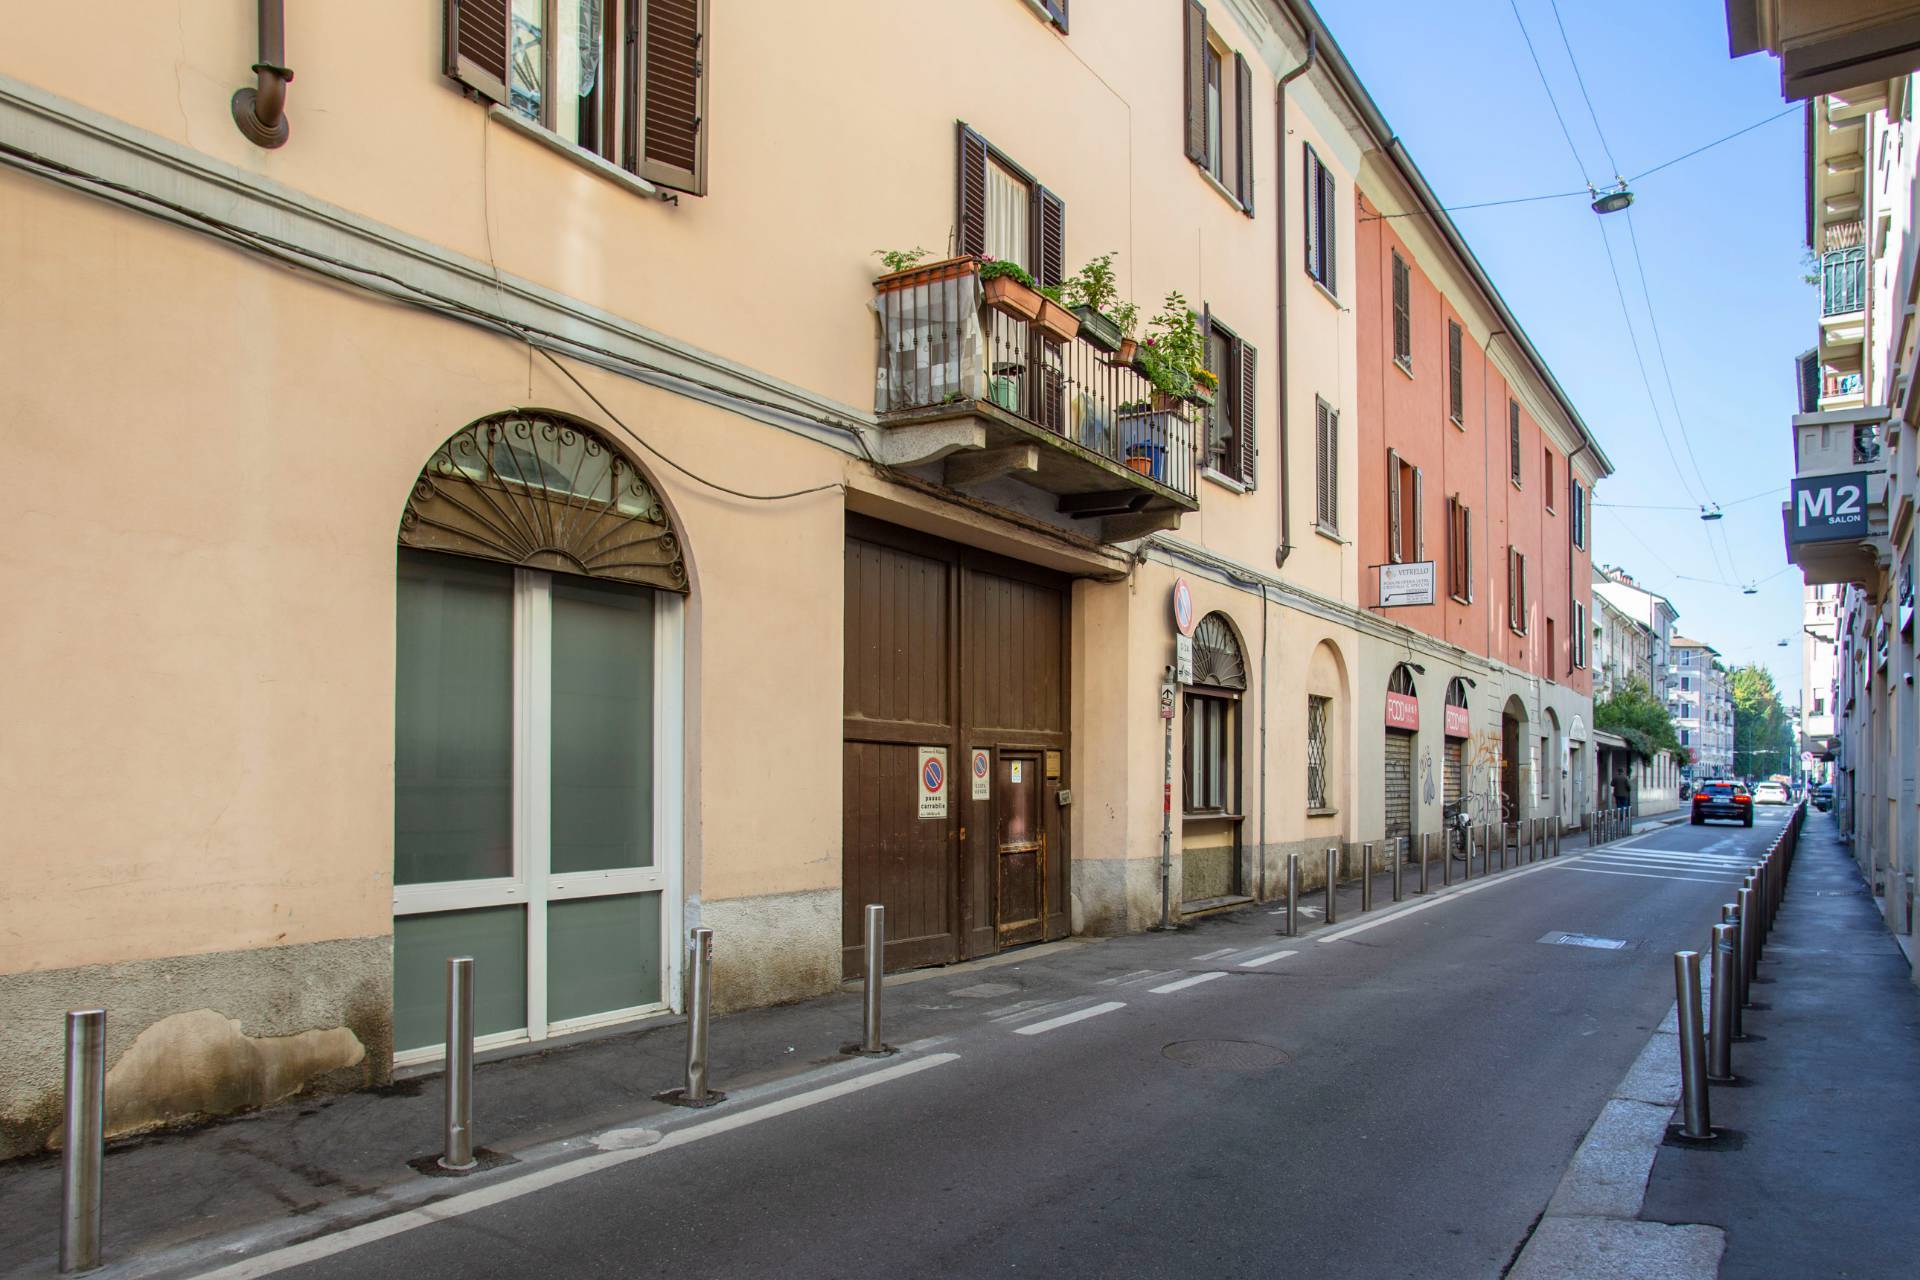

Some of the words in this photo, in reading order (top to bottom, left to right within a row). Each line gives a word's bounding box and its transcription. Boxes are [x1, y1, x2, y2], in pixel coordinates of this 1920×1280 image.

[1798, 485, 1861, 527] M2
[1828, 514, 1861, 525] SALON
[1398, 568, 1429, 576] VETRELLO
[1388, 699, 1404, 721] FOOD
